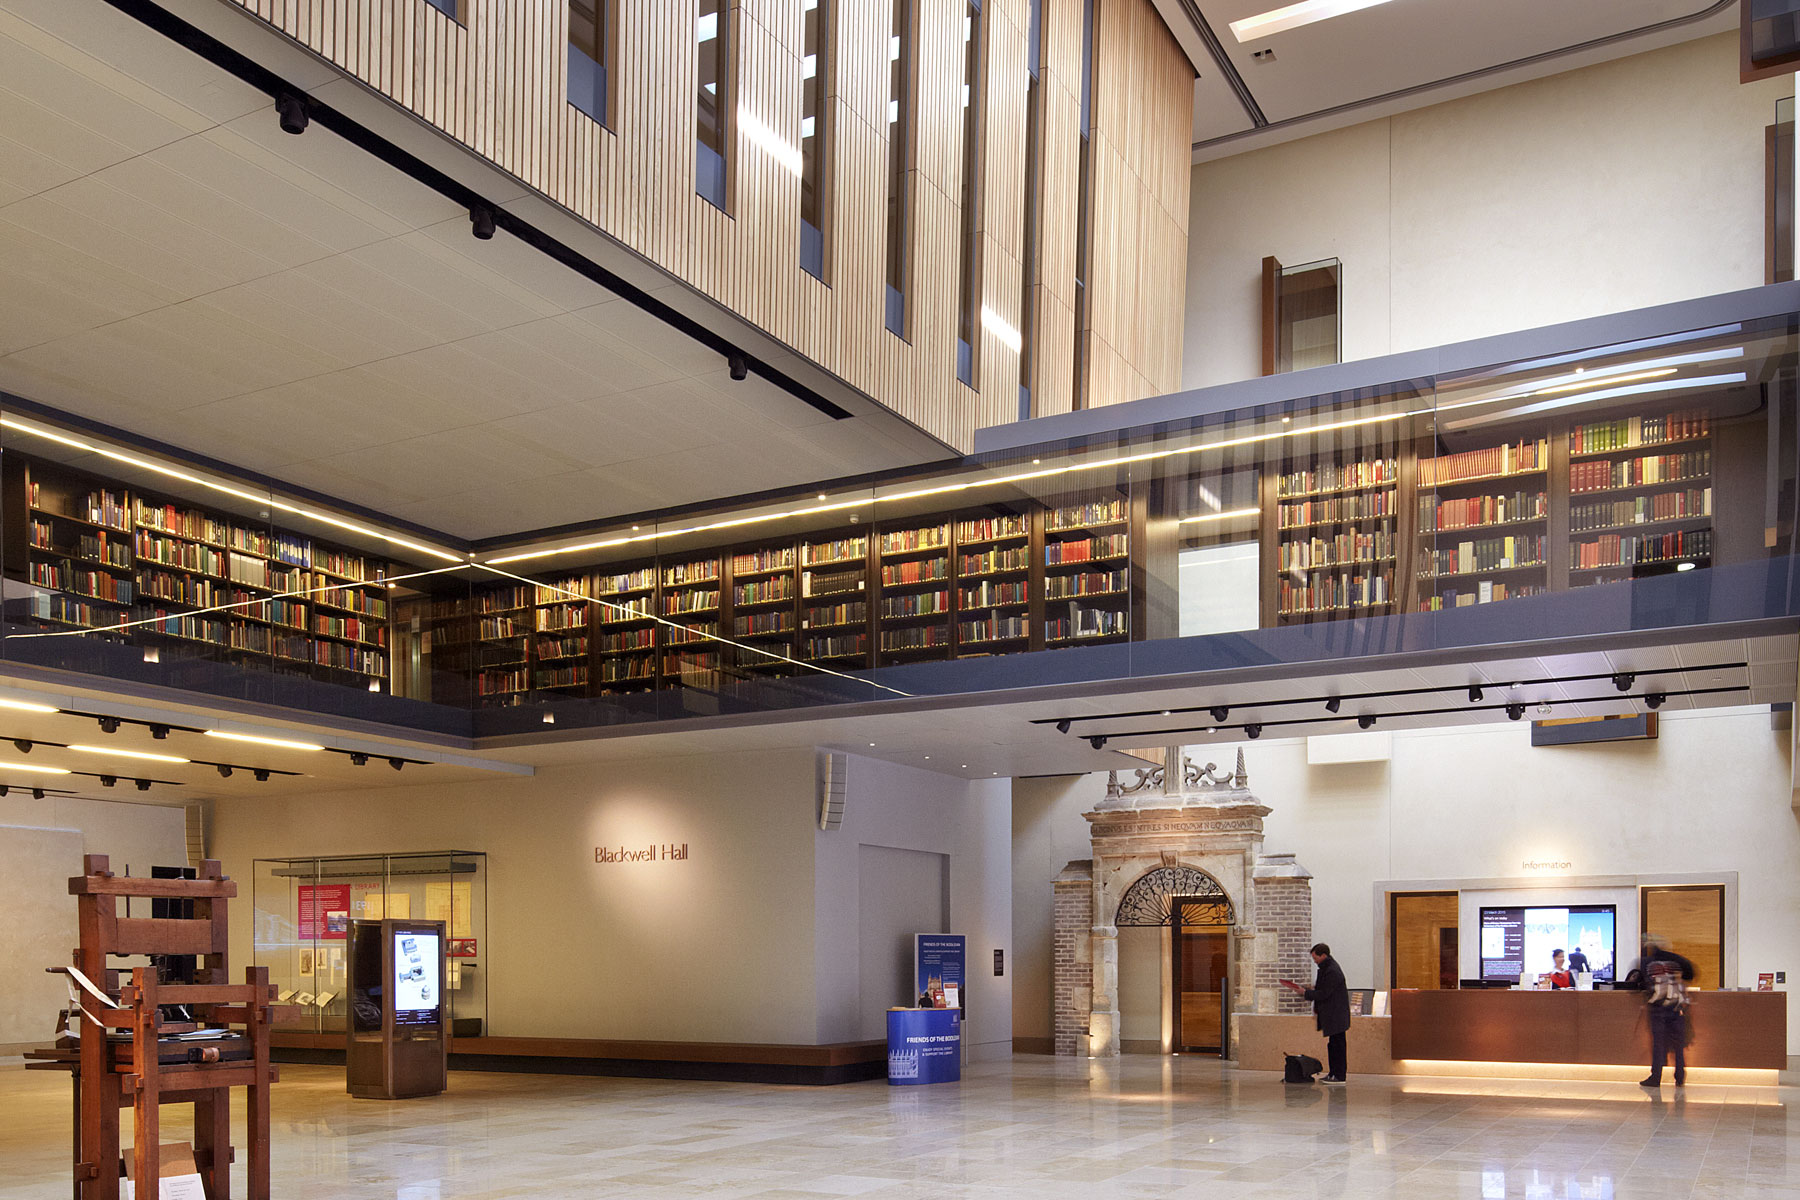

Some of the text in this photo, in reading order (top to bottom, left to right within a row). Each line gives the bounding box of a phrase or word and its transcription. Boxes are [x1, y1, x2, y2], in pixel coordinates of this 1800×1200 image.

[594, 843, 688, 864] Blackwell Hall
[1522, 860, 1572, 870] Information
